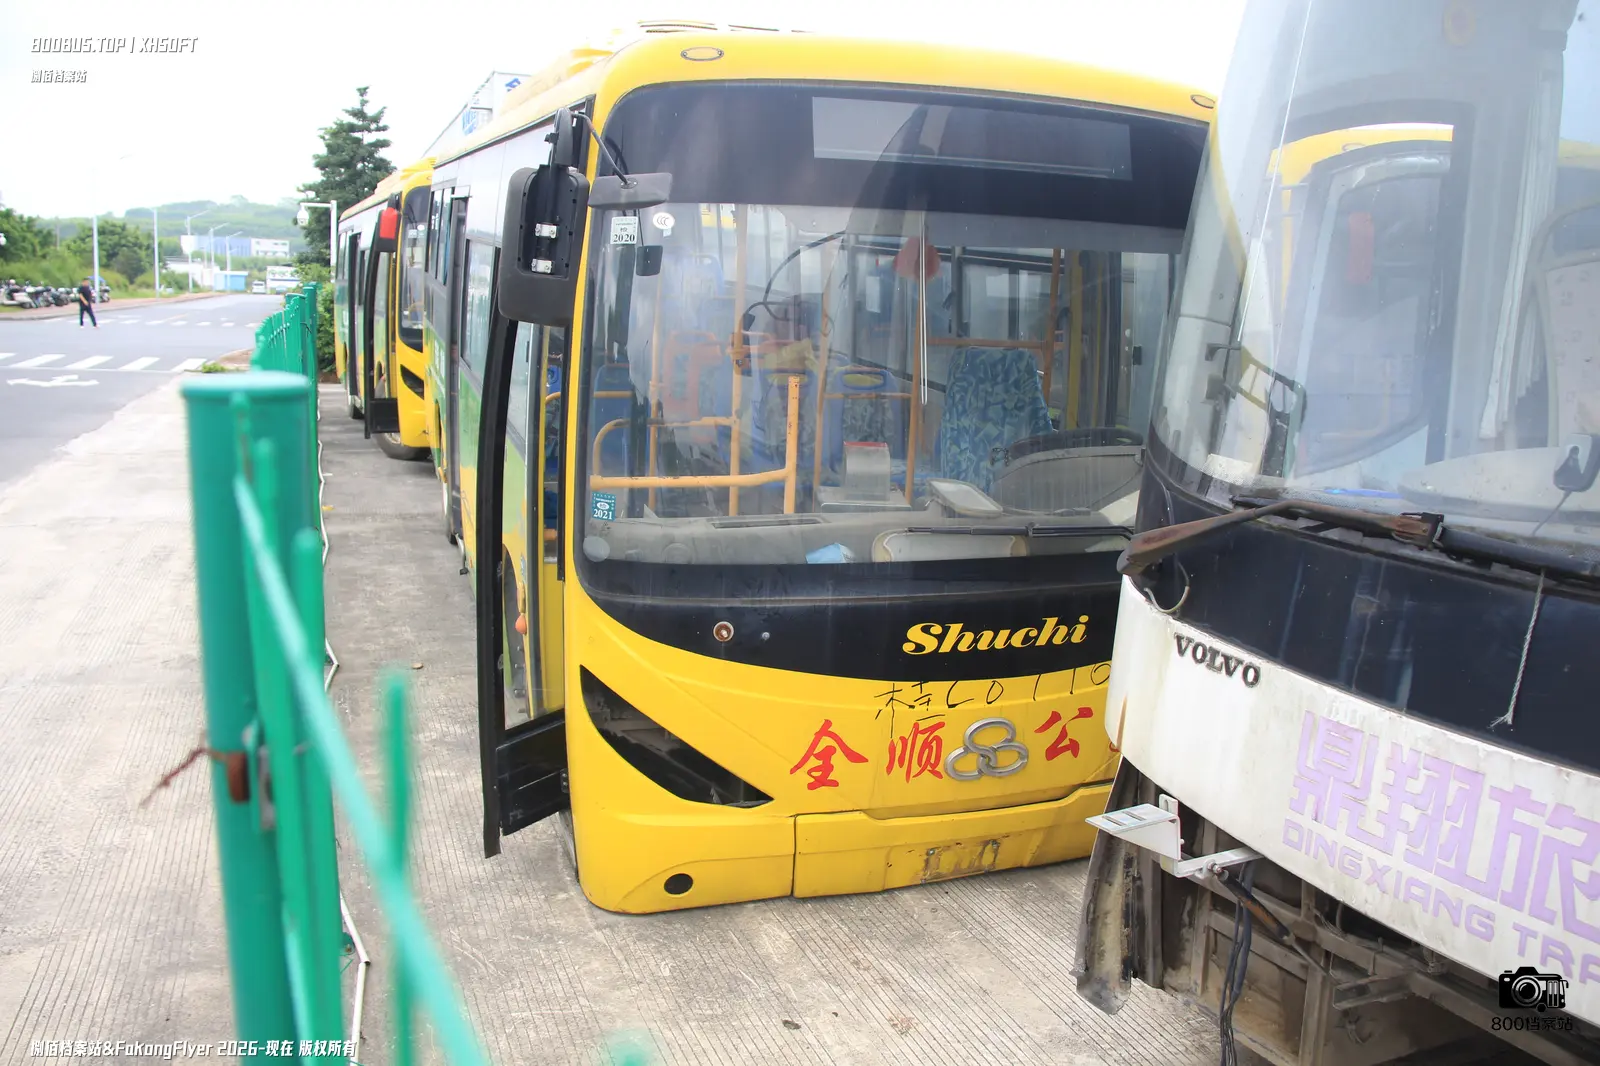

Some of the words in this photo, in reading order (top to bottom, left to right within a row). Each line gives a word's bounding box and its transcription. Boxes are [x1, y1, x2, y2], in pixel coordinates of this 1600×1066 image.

[613, 233, 635, 243] 2020
[593, 508, 613, 520] 2021
[902, 615, 1089, 655] Shuchi
[1174, 632, 1260, 688] VOLVO
[790, 707, 1120, 791] 全顺公
[1282, 819, 1496, 942] DINGXIANG
